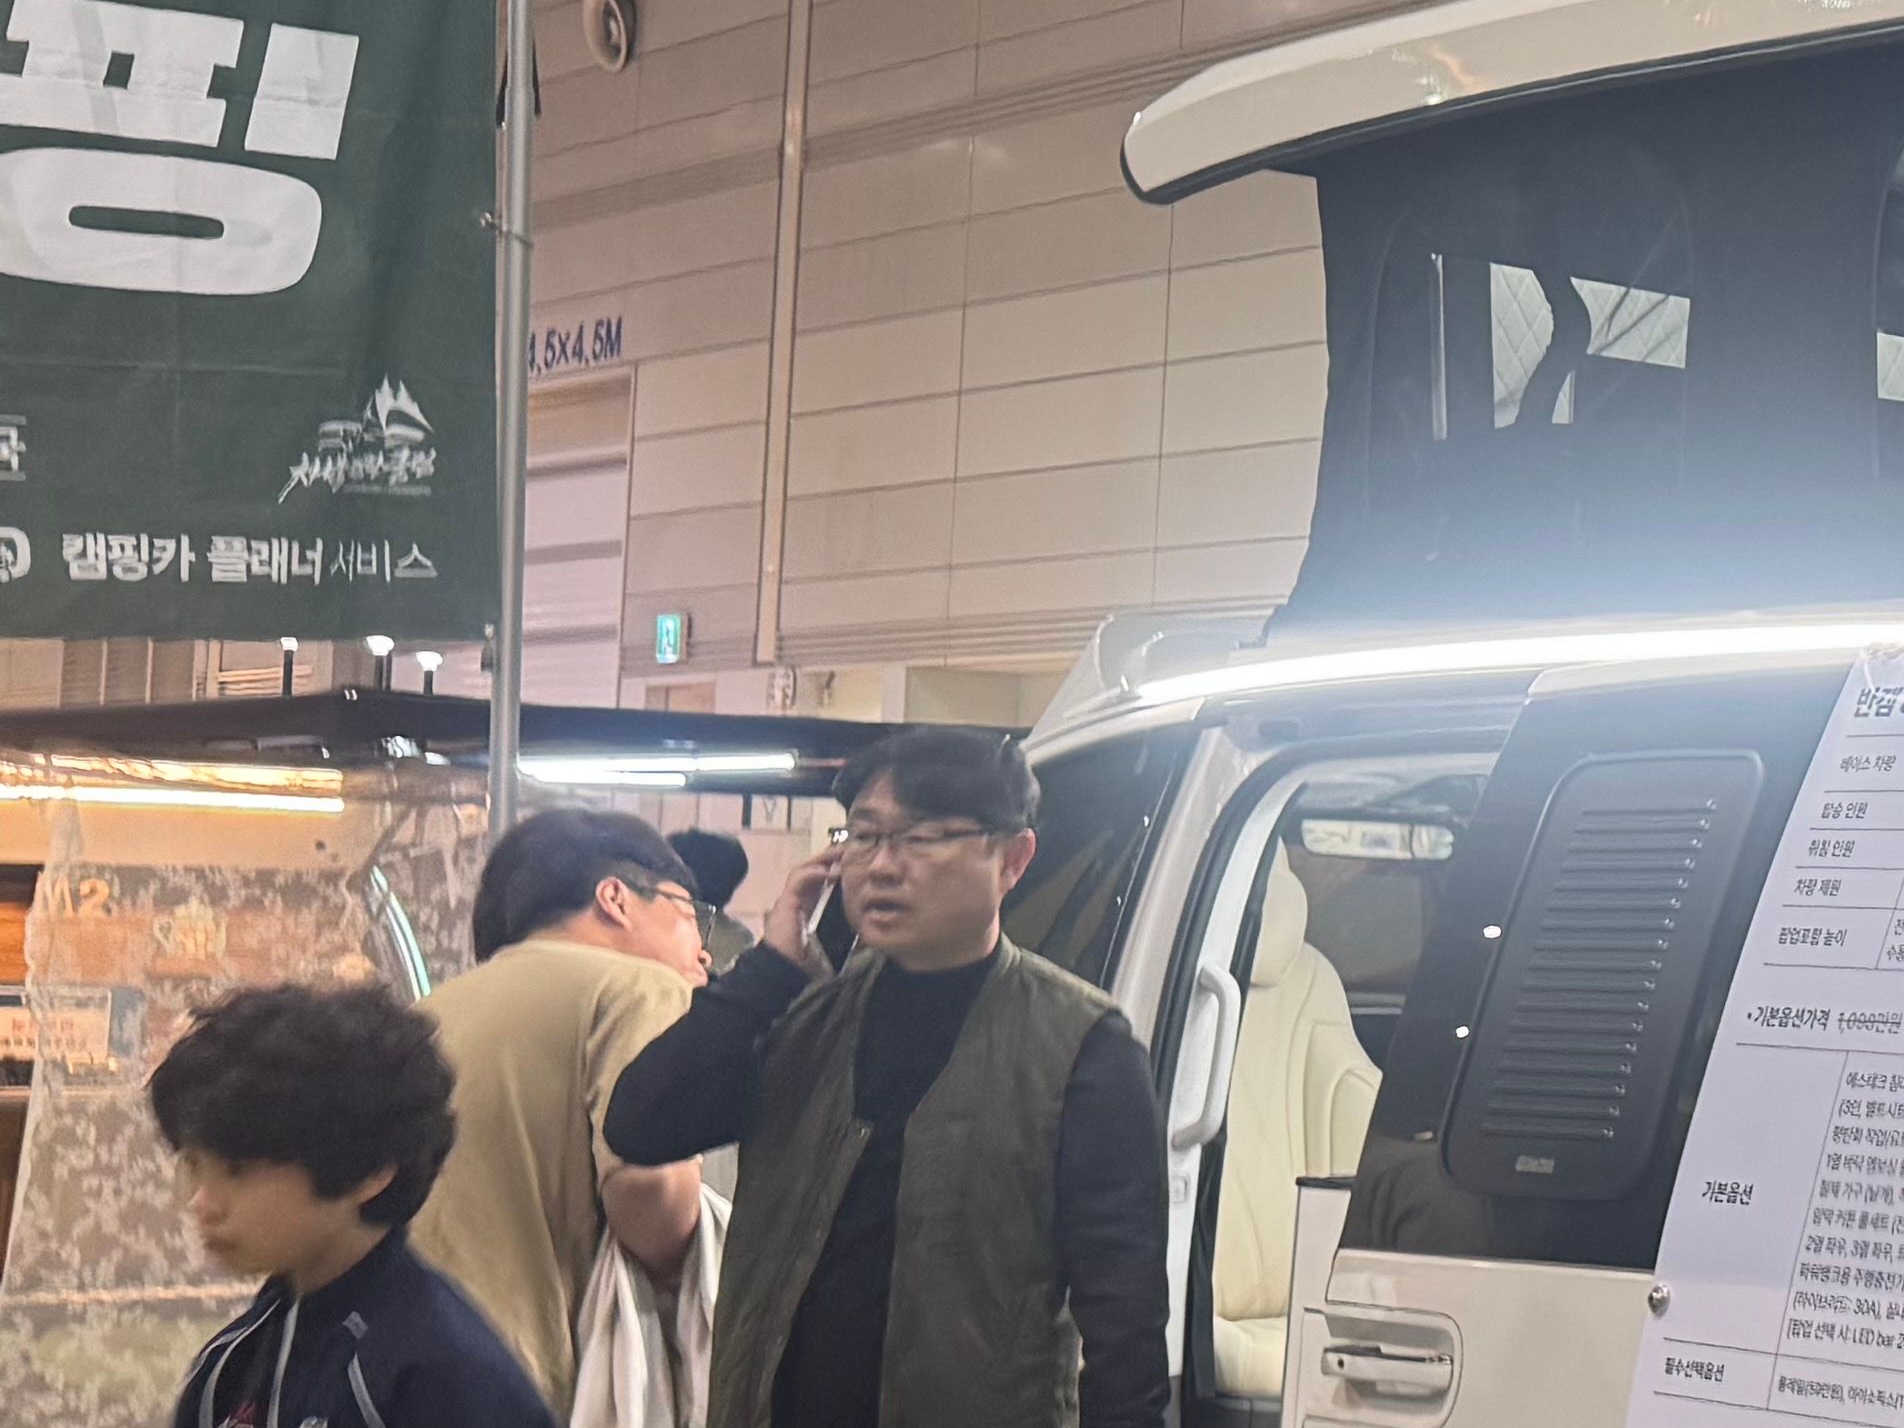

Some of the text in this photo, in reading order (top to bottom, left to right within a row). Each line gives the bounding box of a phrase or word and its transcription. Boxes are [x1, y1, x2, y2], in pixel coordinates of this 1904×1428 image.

[63, 531, 438, 586] 캠핑카 플래너 서비스
[1840, 754, 1896, 773] 베이스 차량
[1845, 802, 1868, 819] 인원
[1794, 878, 1841, 897] 차량 제원
[1822, 927, 1847, 947] 높이
[1702, 1180, 1754, 1205] 기본옵션
